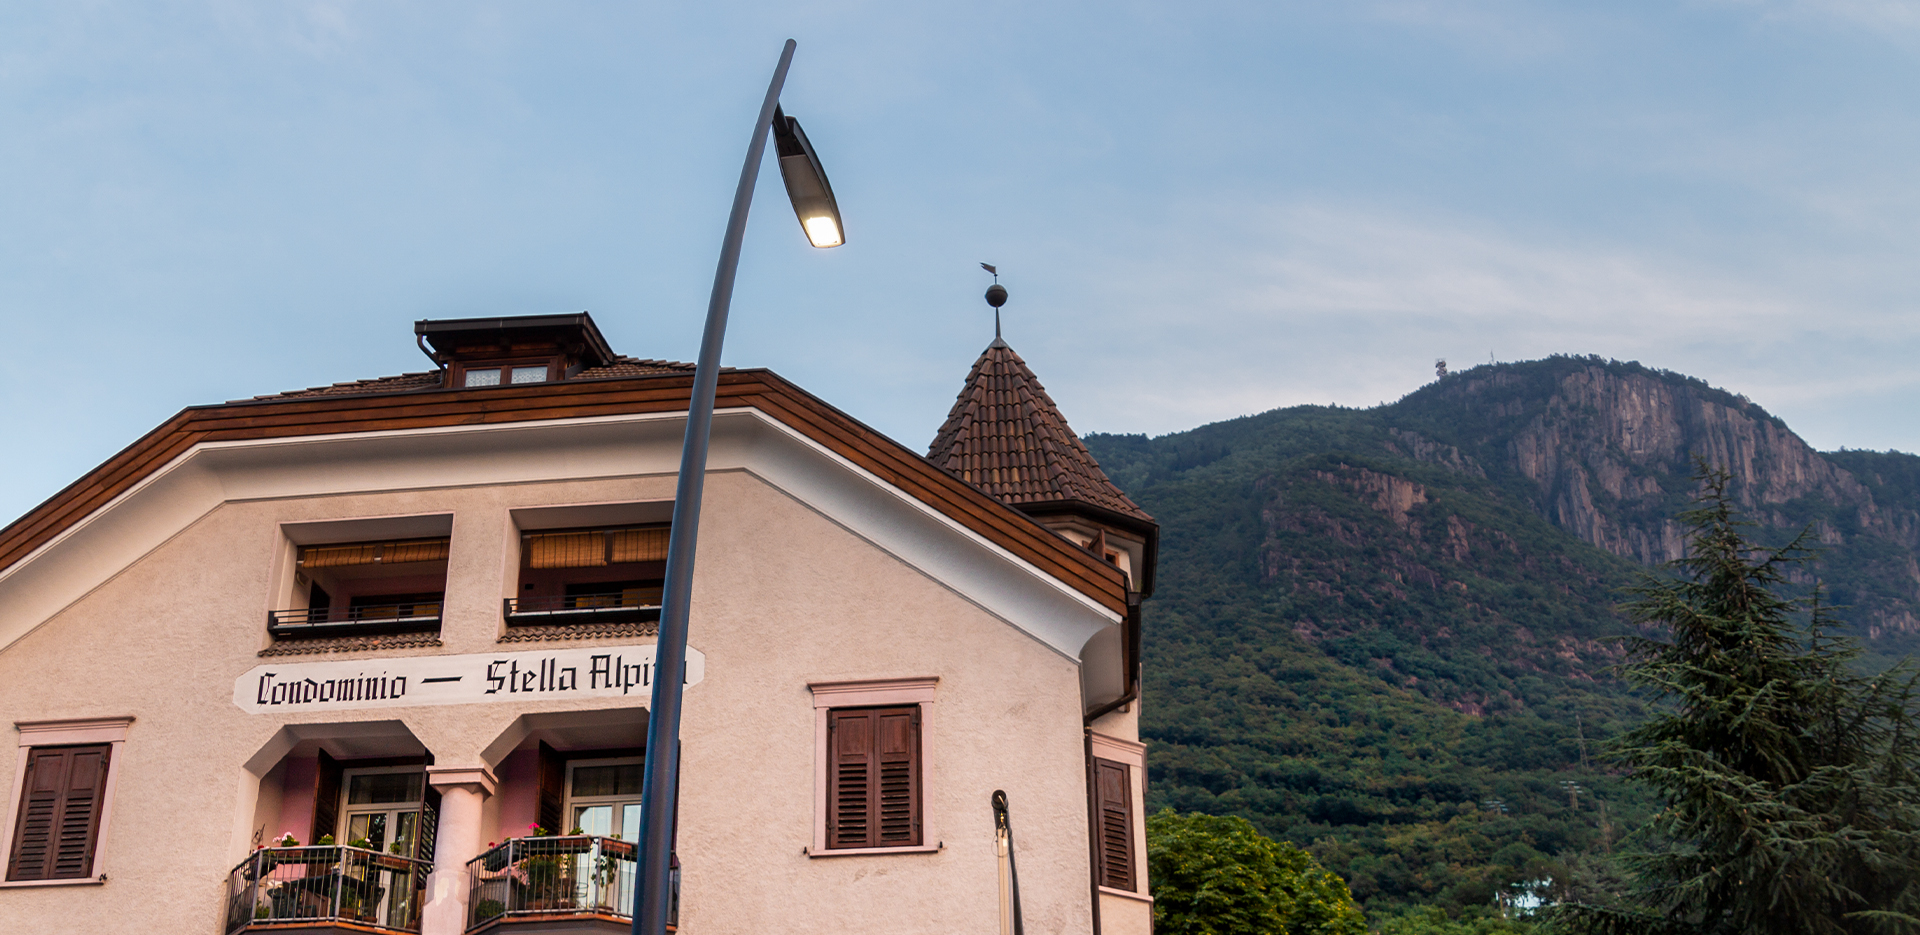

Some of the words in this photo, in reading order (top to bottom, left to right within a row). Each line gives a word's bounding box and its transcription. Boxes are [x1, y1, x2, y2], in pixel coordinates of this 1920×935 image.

[256, 671, 407, 707] Condominio
[484, 657, 577, 695] Stella
[588, 653, 688, 695] Alpi
